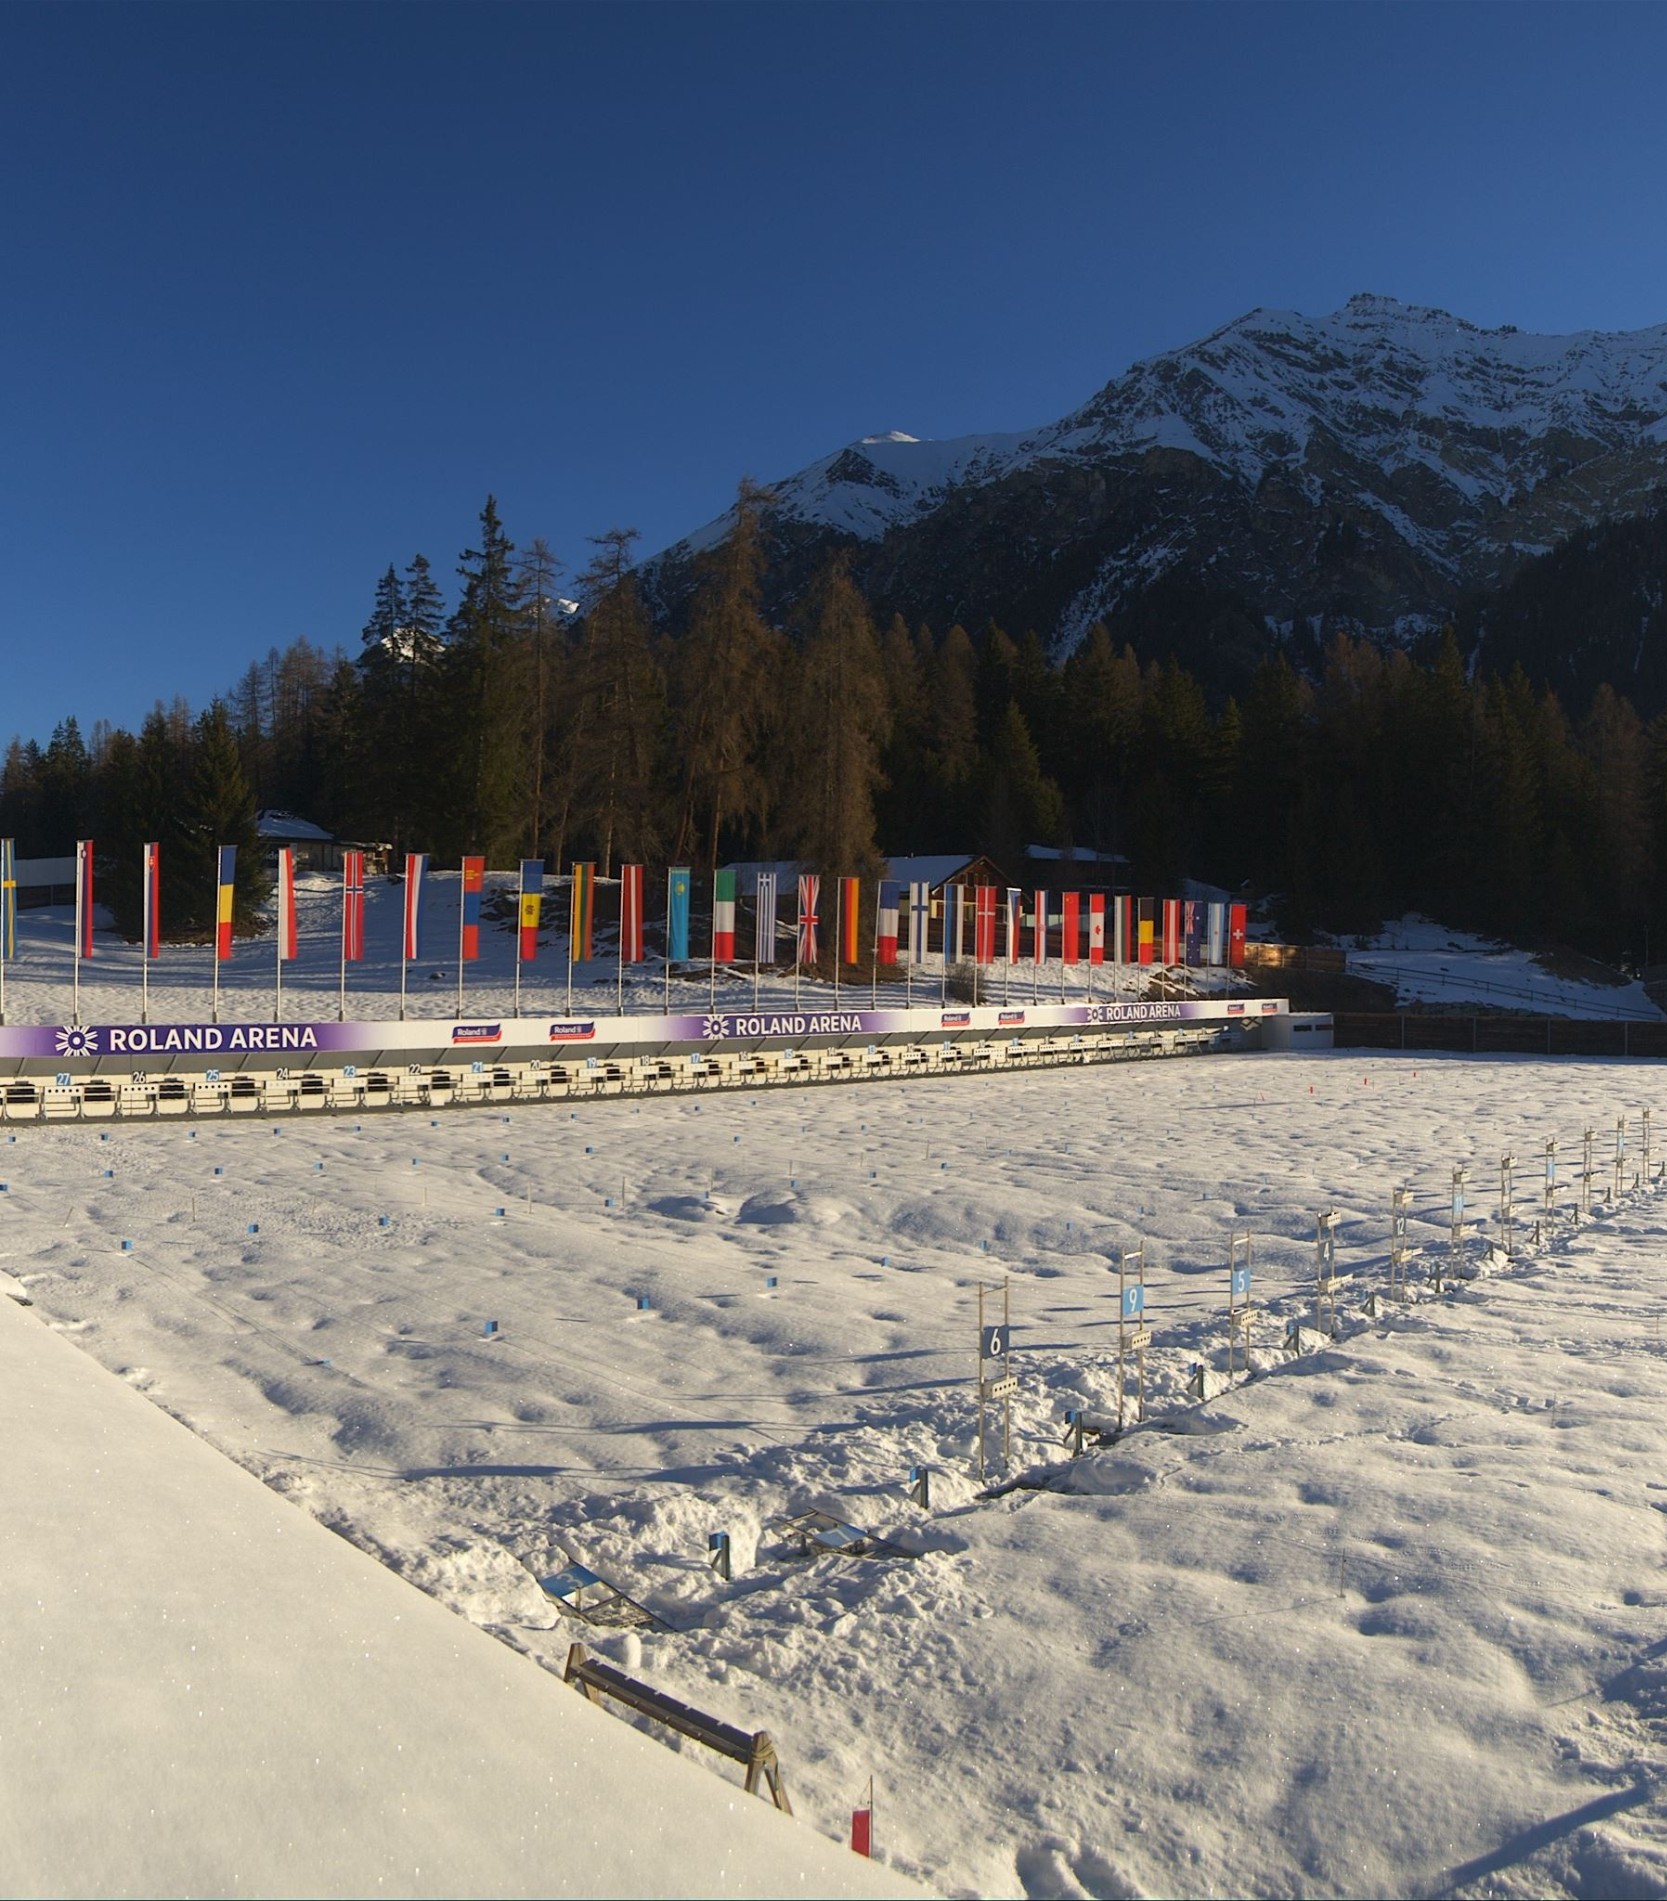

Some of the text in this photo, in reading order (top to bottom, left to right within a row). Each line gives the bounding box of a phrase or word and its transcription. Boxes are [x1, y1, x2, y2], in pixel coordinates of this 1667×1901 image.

[1106, 1004, 1181, 1021] ROLAND ARENA
[456, 1028, 481, 1037] Roland
[554, 1025, 577, 1034] Roland
[735, 1015, 862, 1037] ROLAND ARENA
[109, 1026, 318, 1051] ROLAND ARENA
[530, 1059, 541, 1070] 20
[586, 1056, 598, 1068] 19
[641, 1054, 651, 1066] 18
[690, 1052, 701, 1064] 17
[276, 1067, 290, 1080] 24
[343, 1065, 357, 1078] 23
[409, 1063, 422, 1075] 22
[472, 1061, 484, 1073] 21
[56, 1072, 71, 1086] 27
[132, 1071, 146, 1084] 26
[206, 1069, 220, 1082] 25
[1396, 1217, 1406, 1236] 12
[1323, 1241, 1330, 1261] 4
[1237, 1273, 1246, 1293] 5
[1128, 1288, 1138, 1313] 9
[989, 1327, 1002, 1355] 6
